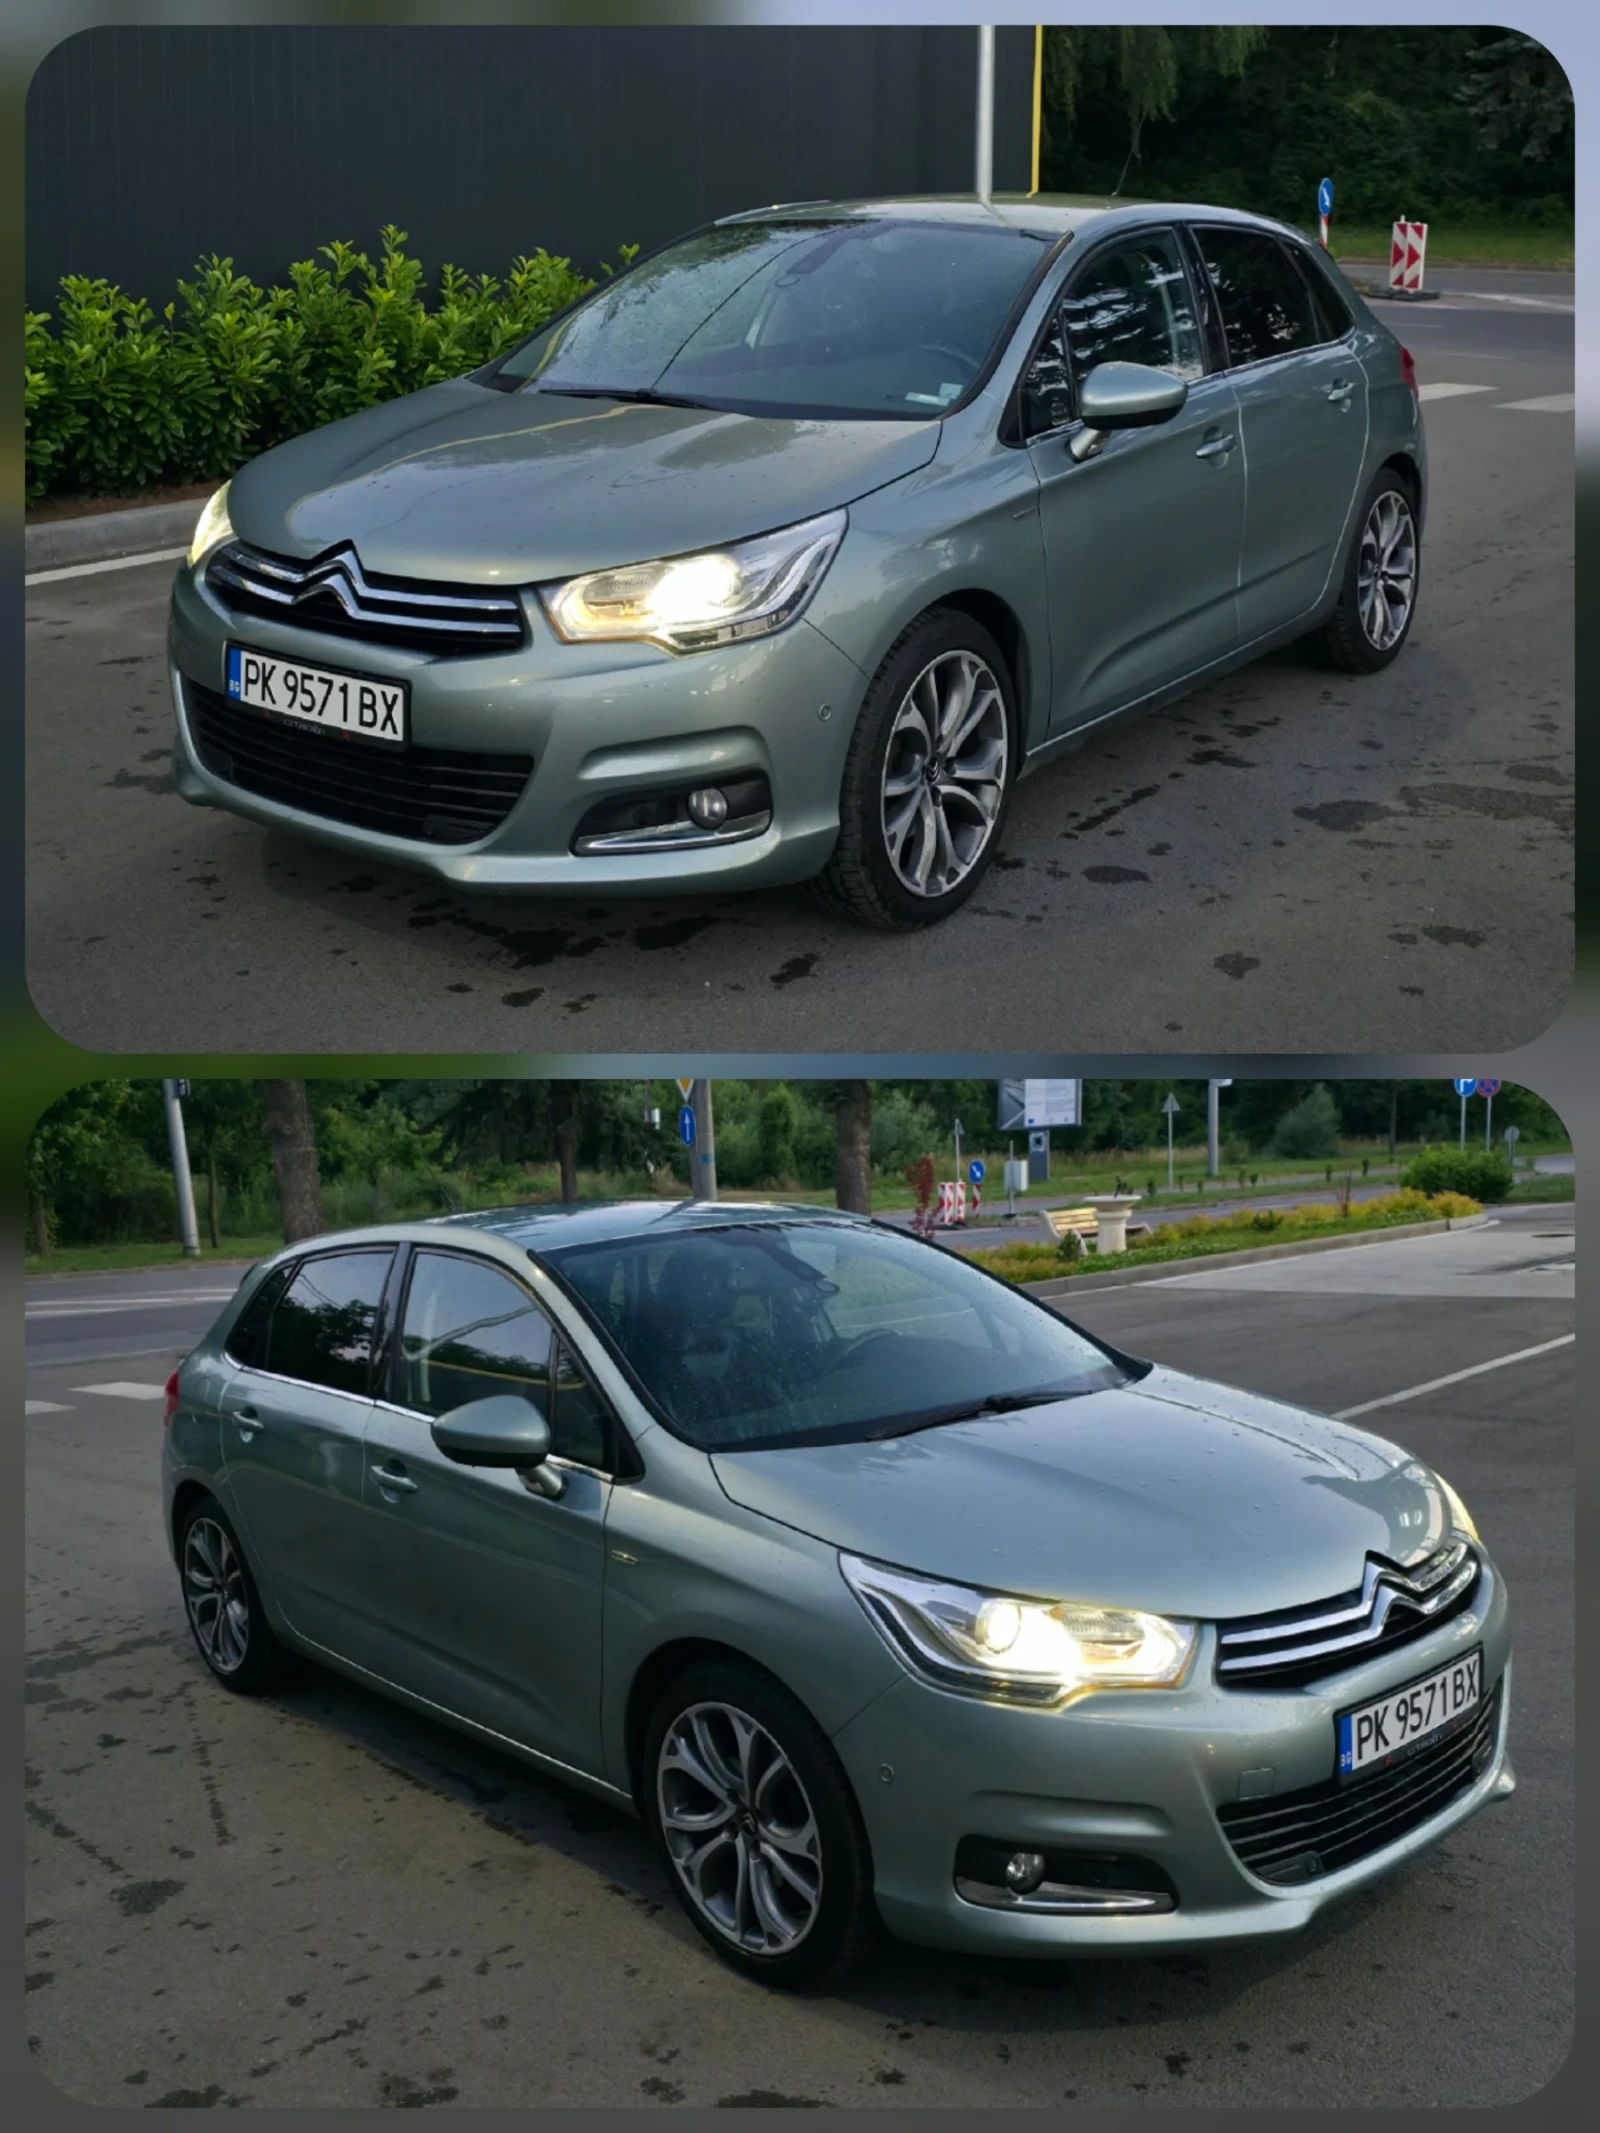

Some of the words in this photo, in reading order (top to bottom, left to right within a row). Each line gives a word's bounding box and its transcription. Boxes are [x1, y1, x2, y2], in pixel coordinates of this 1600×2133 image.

[229, 679, 240, 692] BG
[244, 658, 277, 705] PK
[283, 669, 349, 723] 9571
[358, 686, 400, 735] BX
[1356, 1704, 1390, 1760] PK
[1395, 1676, 1448, 1740] 9571
[1453, 1659, 1478, 1710] BX
